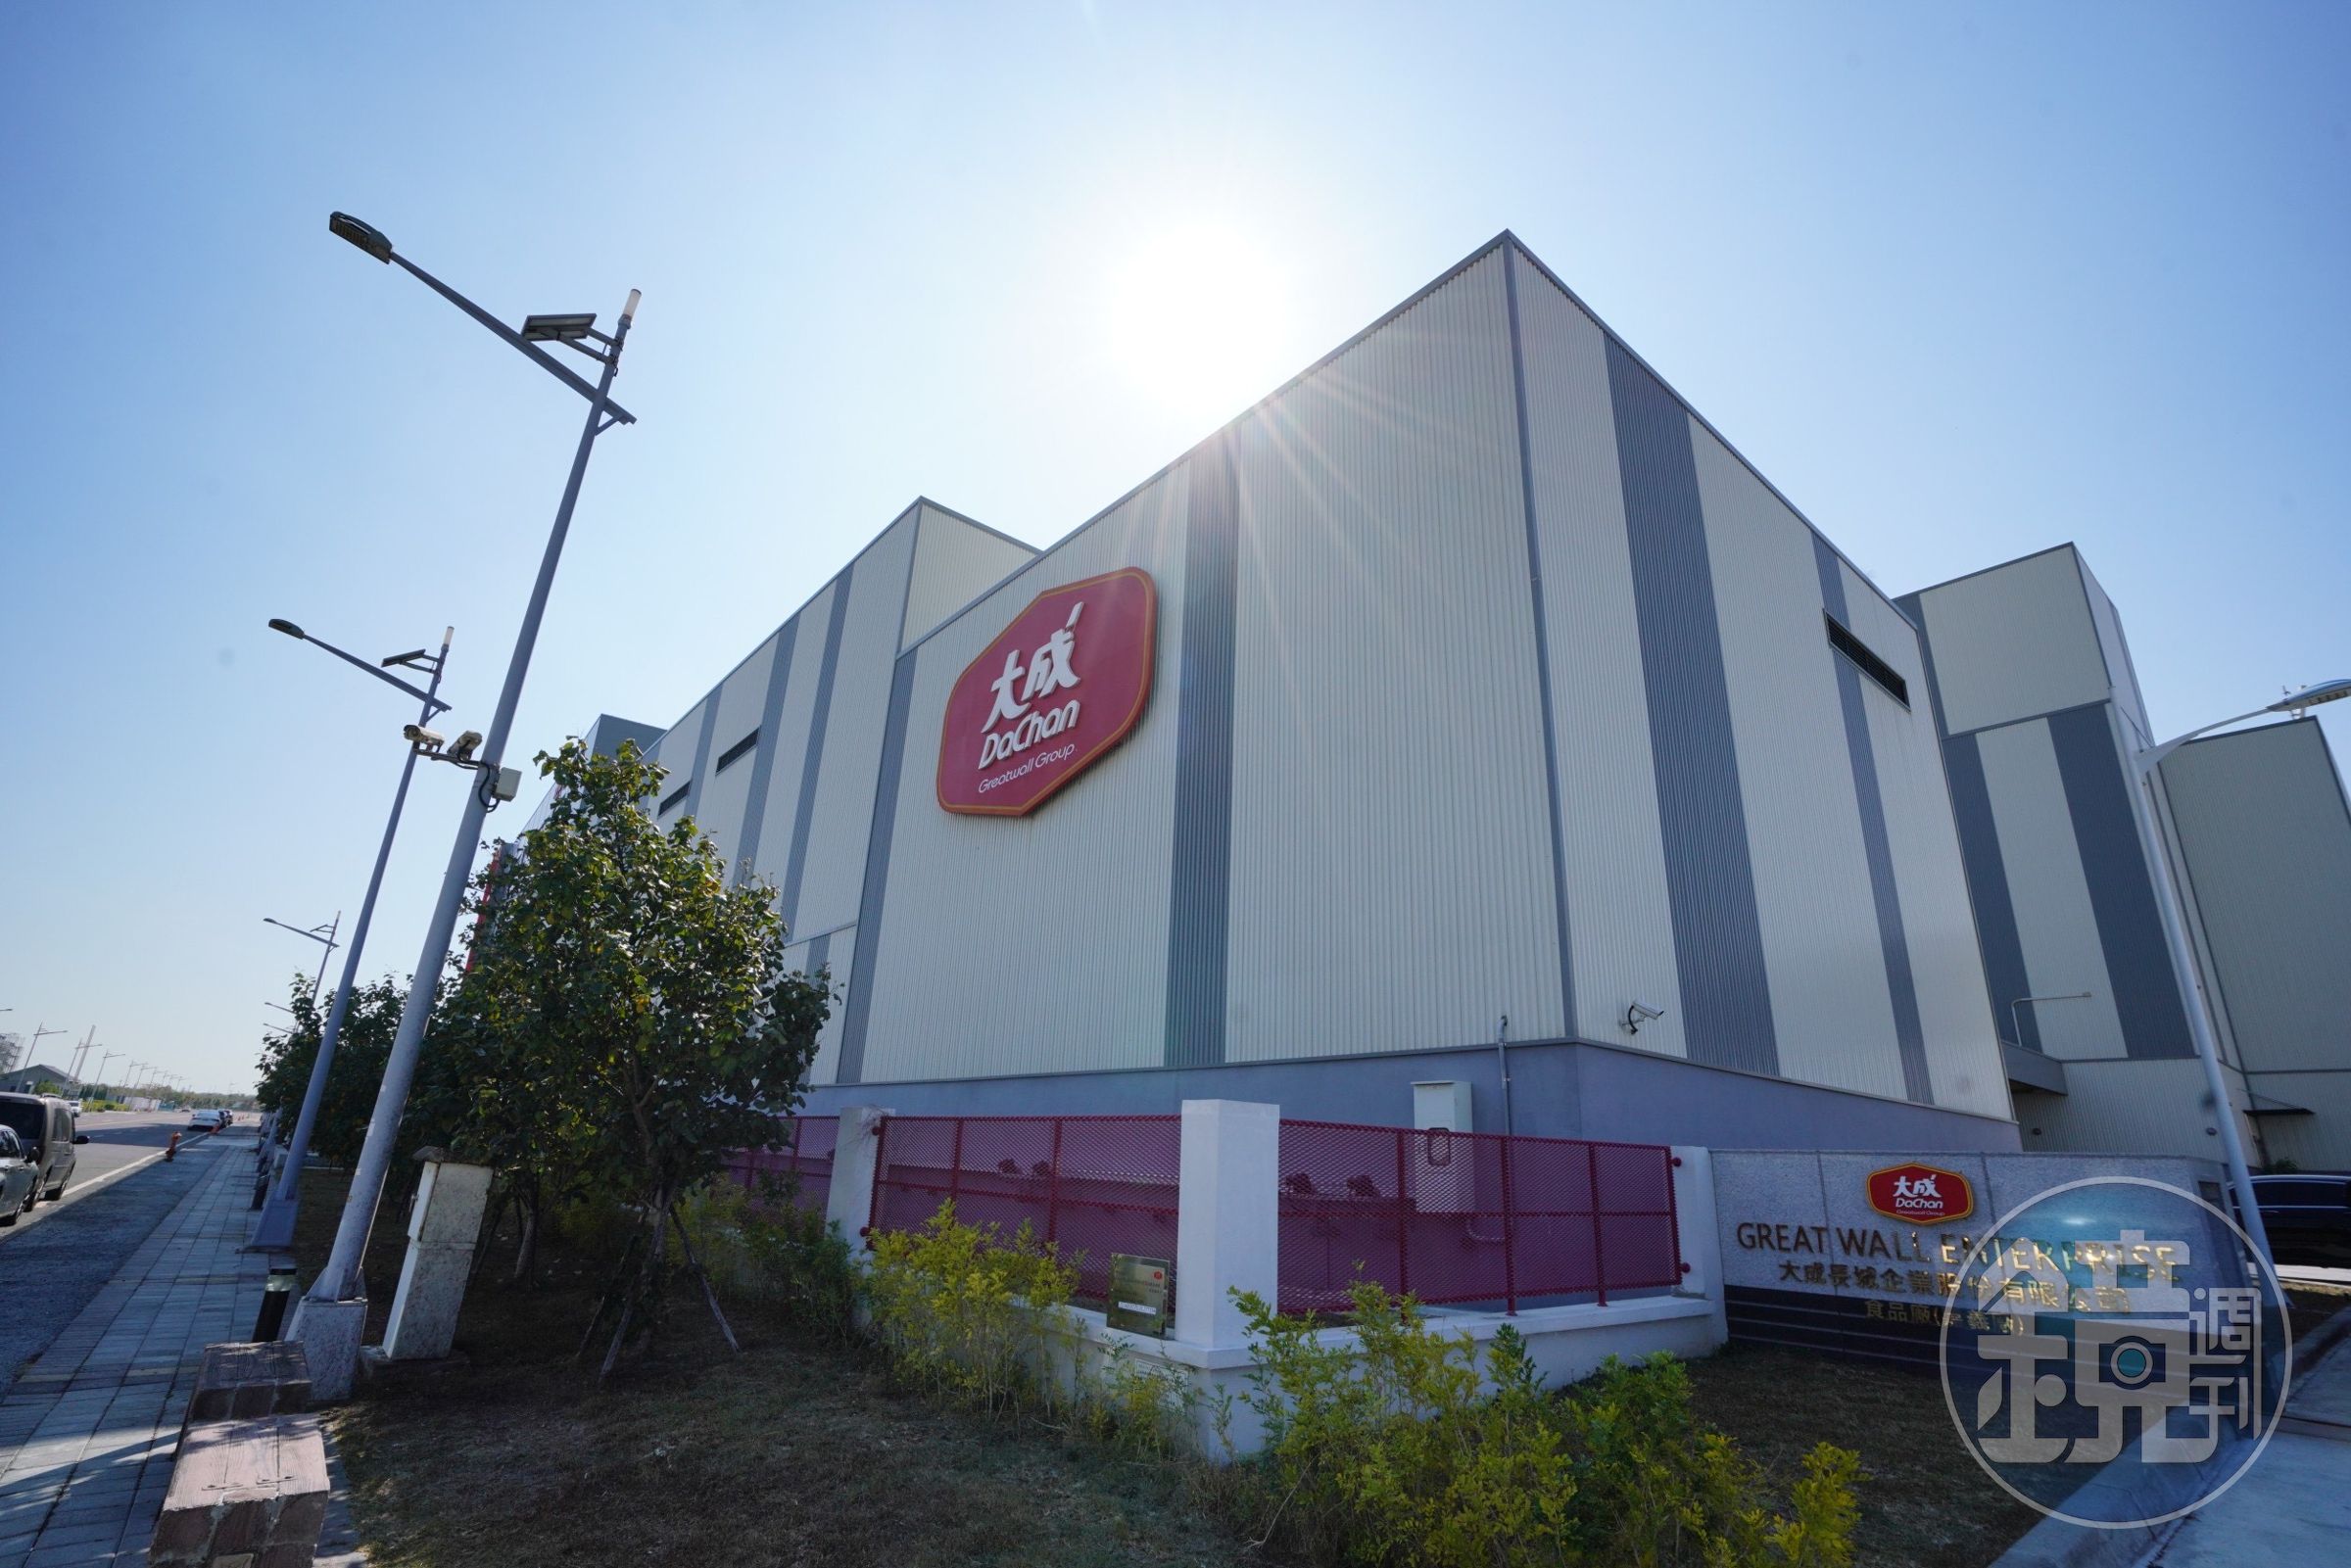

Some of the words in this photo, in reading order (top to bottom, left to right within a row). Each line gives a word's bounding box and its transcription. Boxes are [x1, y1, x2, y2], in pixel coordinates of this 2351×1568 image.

[981, 601, 1085, 734] 大成
[978, 699, 1080, 770] DaChan
[978, 758, 1033, 793] Greatwall
[1034, 742, 1075, 769] Group
[1893, 1173, 1943, 1198] 大成
[1895, 1198, 1943, 1209] DaChan
[1737, 1222, 1829, 1253] GREAT
[1836, 1226, 1931, 1263] WALL
[1940, 1233, 2181, 1281] ENTERPRISE
